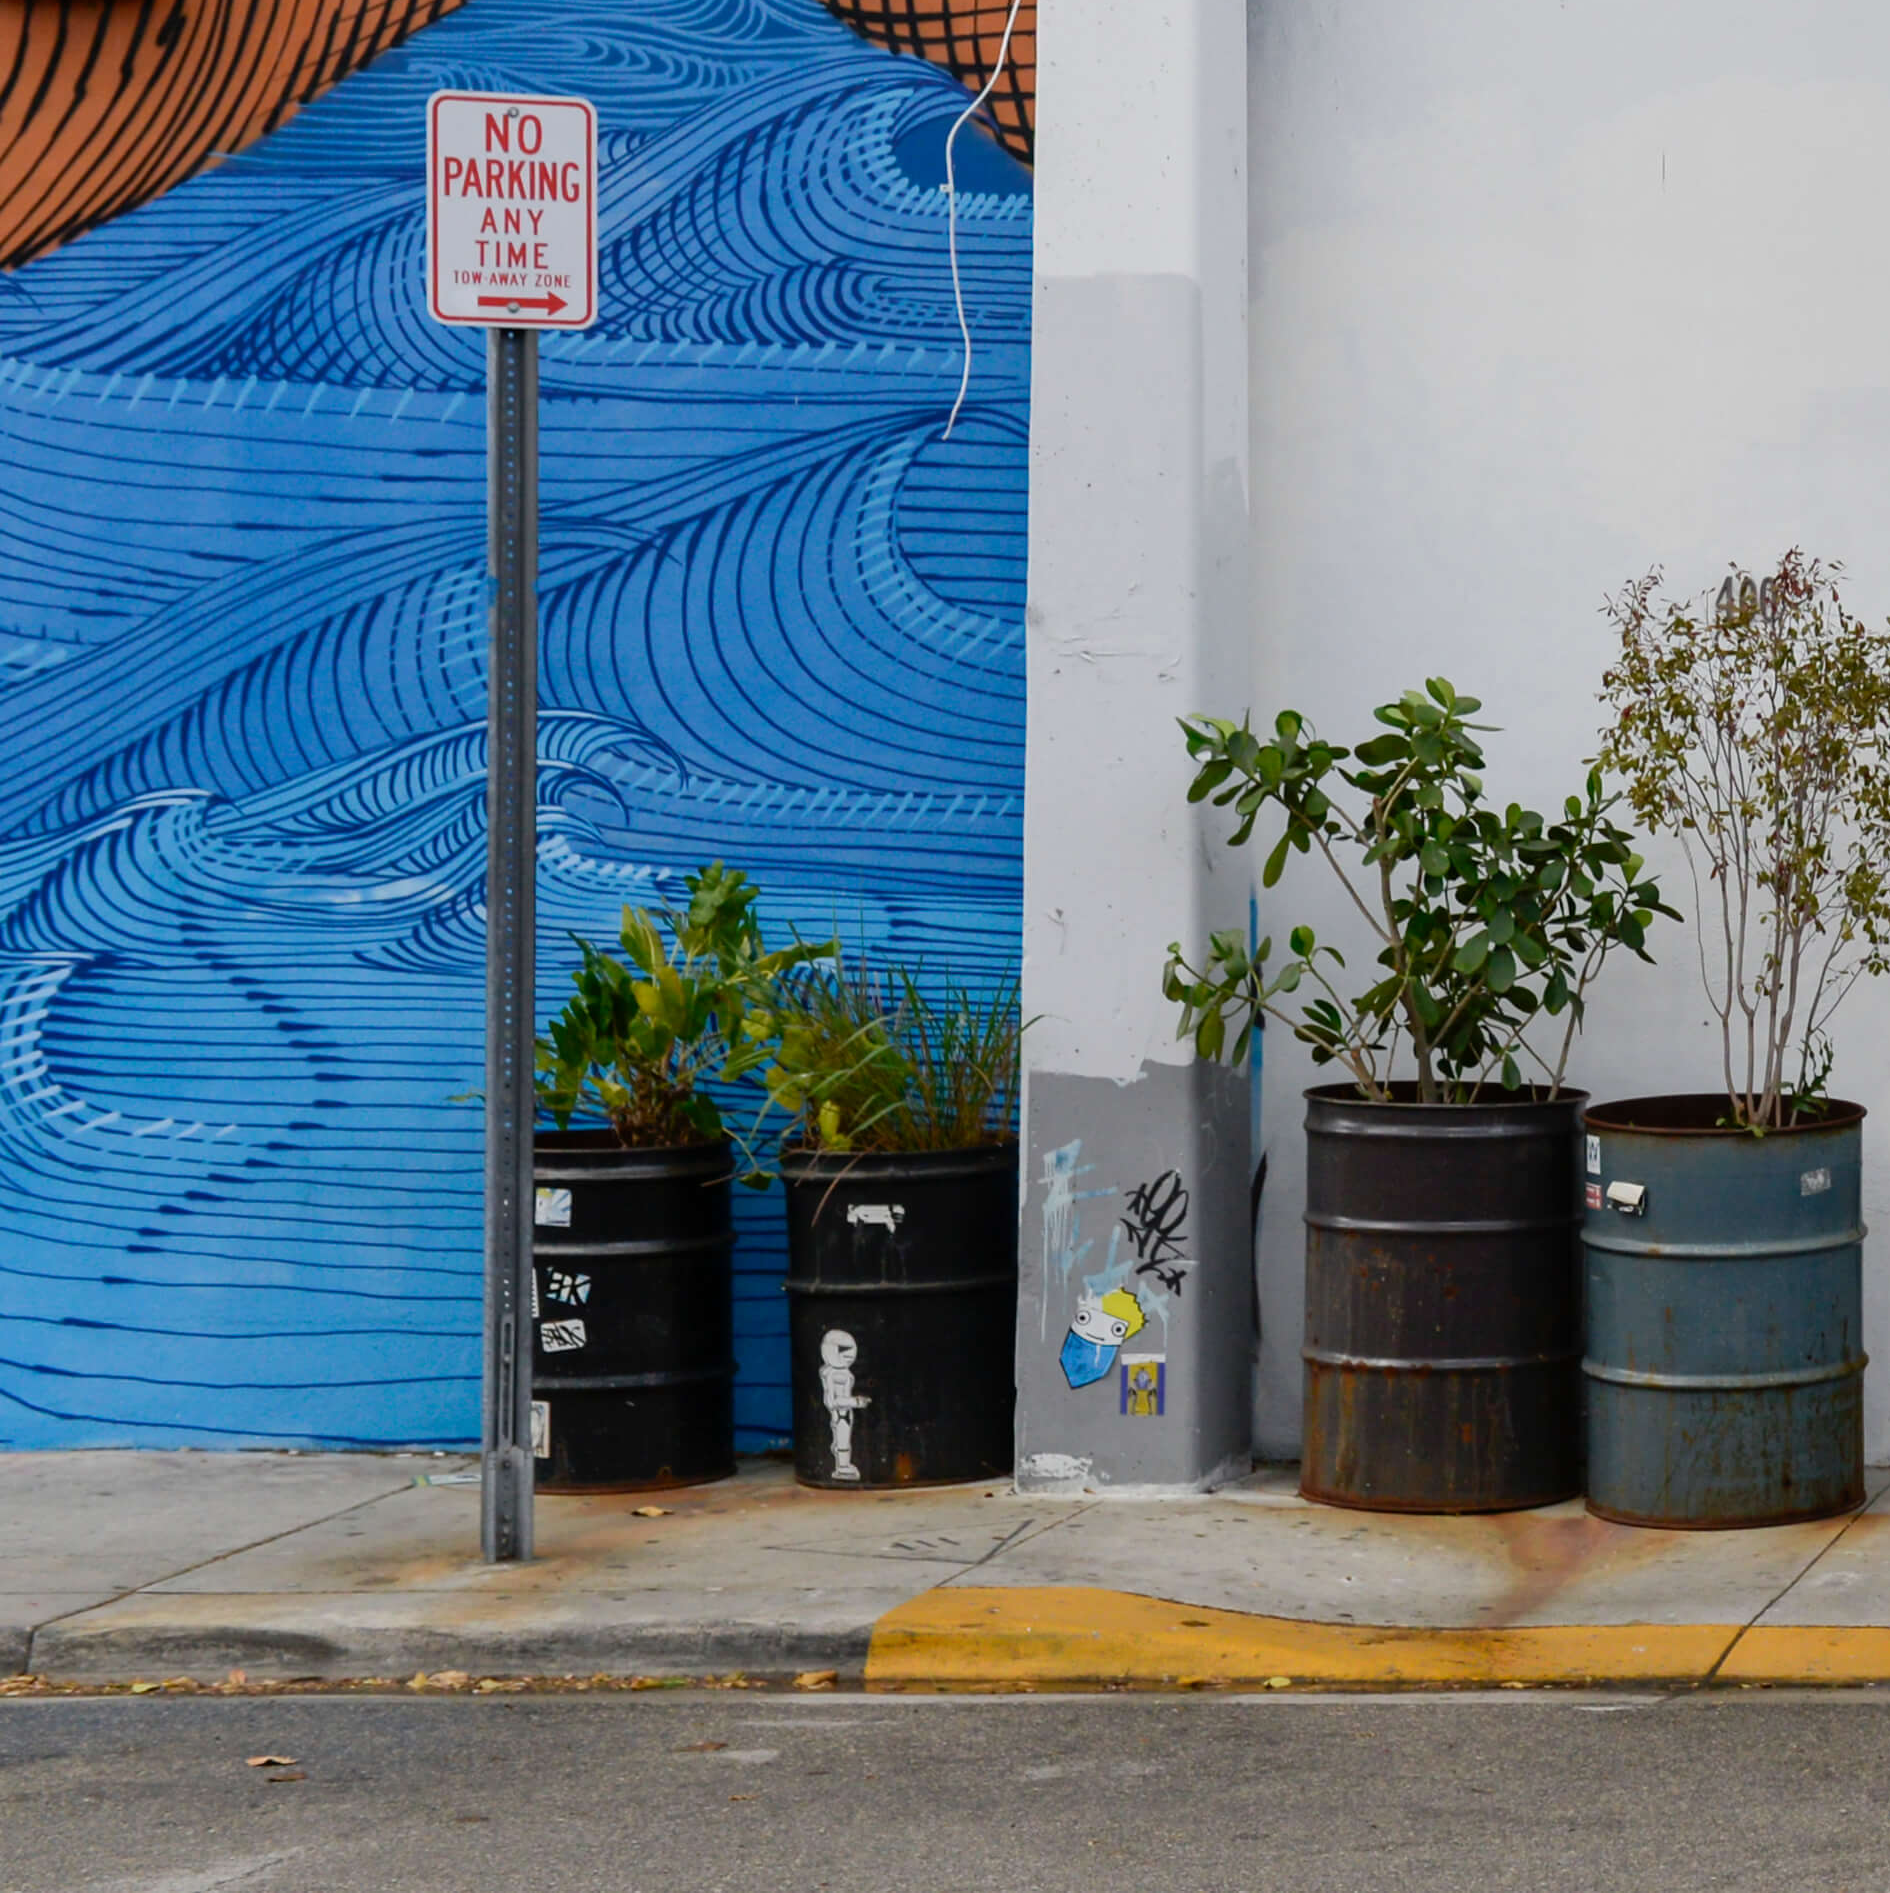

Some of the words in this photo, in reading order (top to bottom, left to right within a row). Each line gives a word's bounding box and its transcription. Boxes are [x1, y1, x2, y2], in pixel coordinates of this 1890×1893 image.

[485, 112, 542, 155] NO
[443, 156, 580, 203] PARKING
[480, 206, 544, 235] ANY
[475, 239, 549, 270] TIME
[535, 273, 571, 288] ZONE
